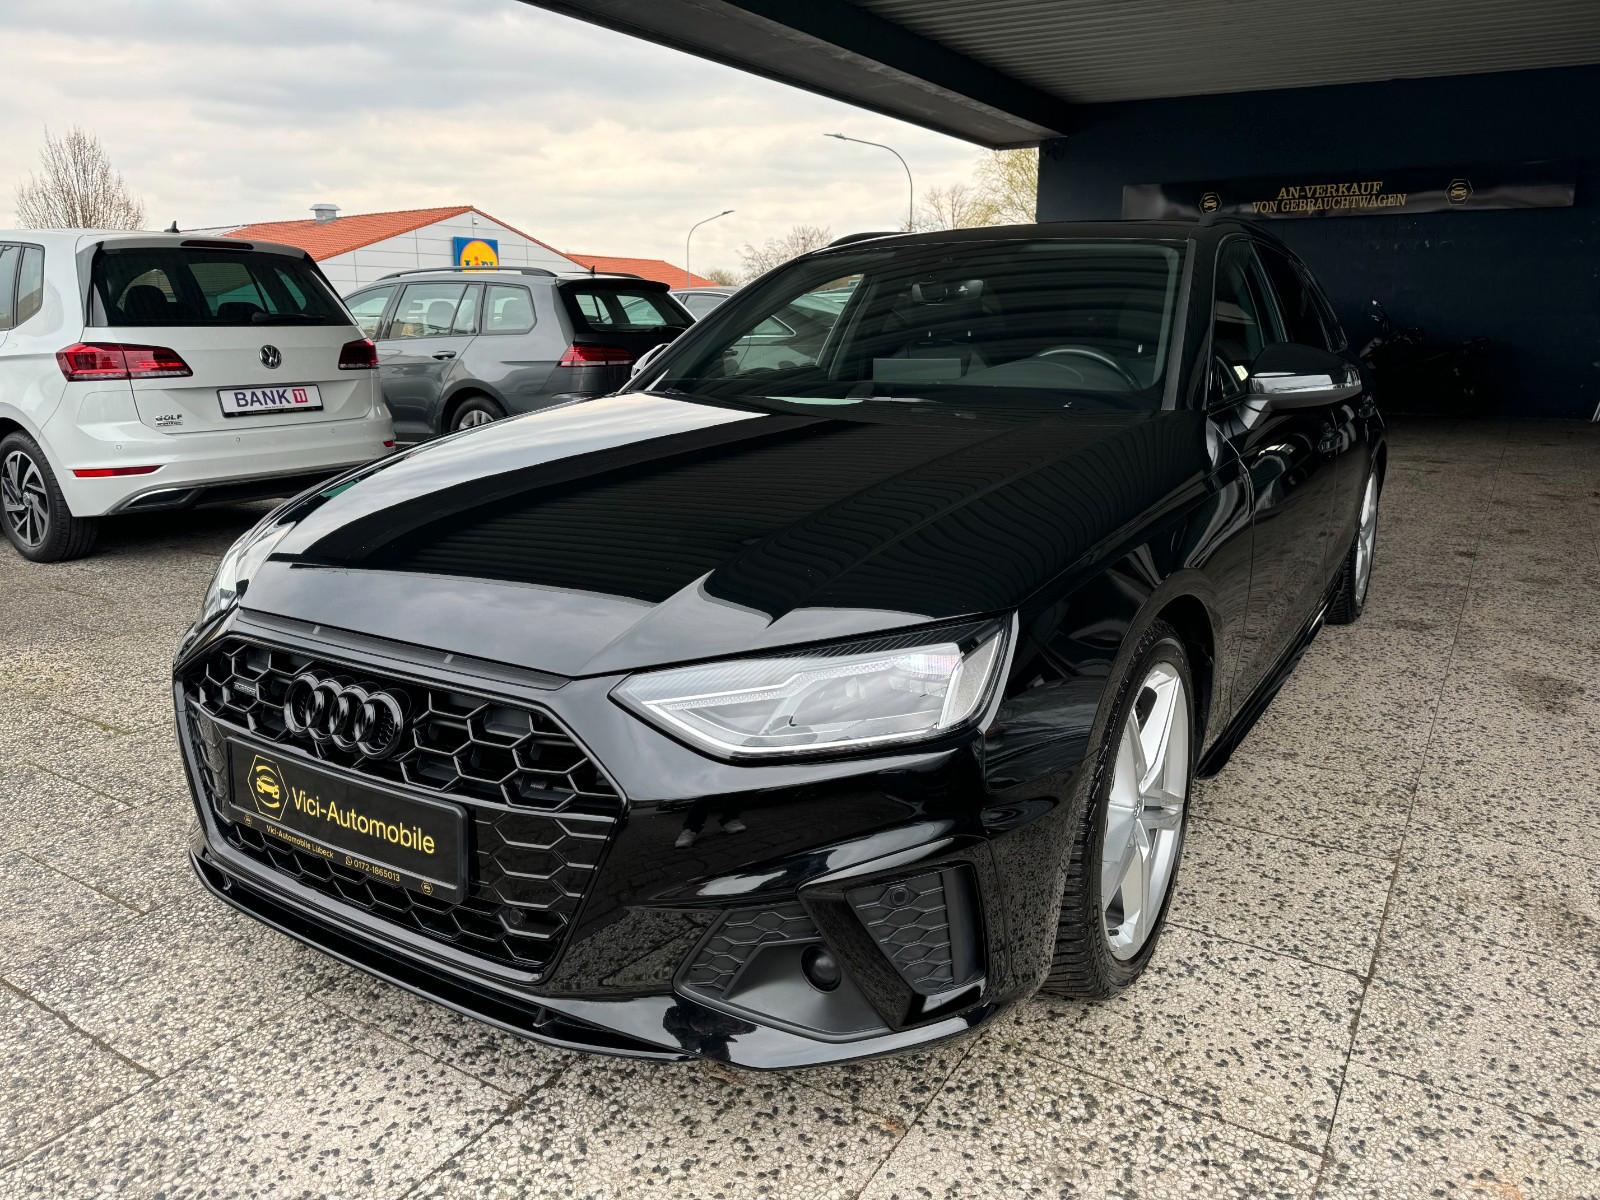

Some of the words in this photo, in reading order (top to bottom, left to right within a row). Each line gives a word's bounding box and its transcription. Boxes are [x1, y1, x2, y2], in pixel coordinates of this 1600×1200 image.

[1277, 181, 1383, 200] AN-VERKAUF
[1252, 200, 1278, 214] VON
[1281, 193, 1408, 212] GEBRAUCHTWAGEN
[234, 389, 291, 408] BANK
[291, 786, 436, 855] Vici-Automobile
[266, 824, 311, 850] Vici-Automobile
[353, 859, 400, 882] 0172-1865013
